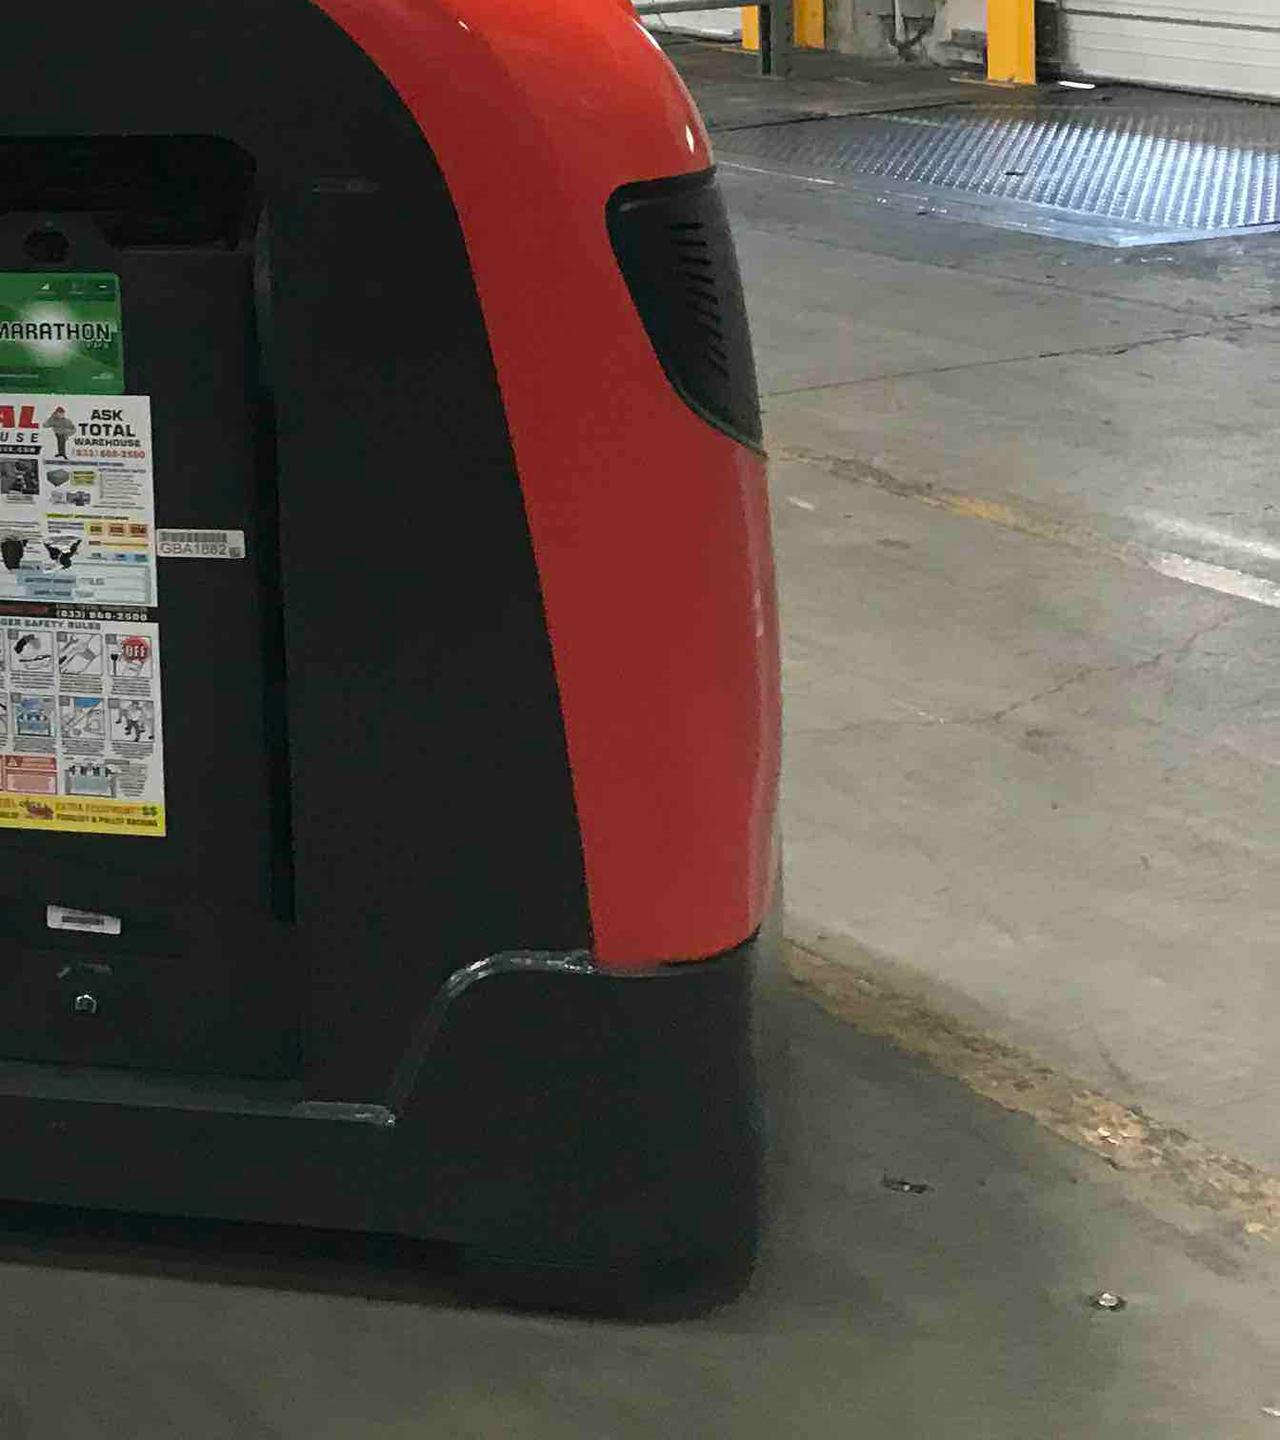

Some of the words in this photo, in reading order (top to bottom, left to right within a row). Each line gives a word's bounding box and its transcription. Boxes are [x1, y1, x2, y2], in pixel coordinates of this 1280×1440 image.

[91, 409, 123, 421] ASK
[78, 423, 136, 437] TOTAL
[74, 438, 141, 448] WAREHOUSE
